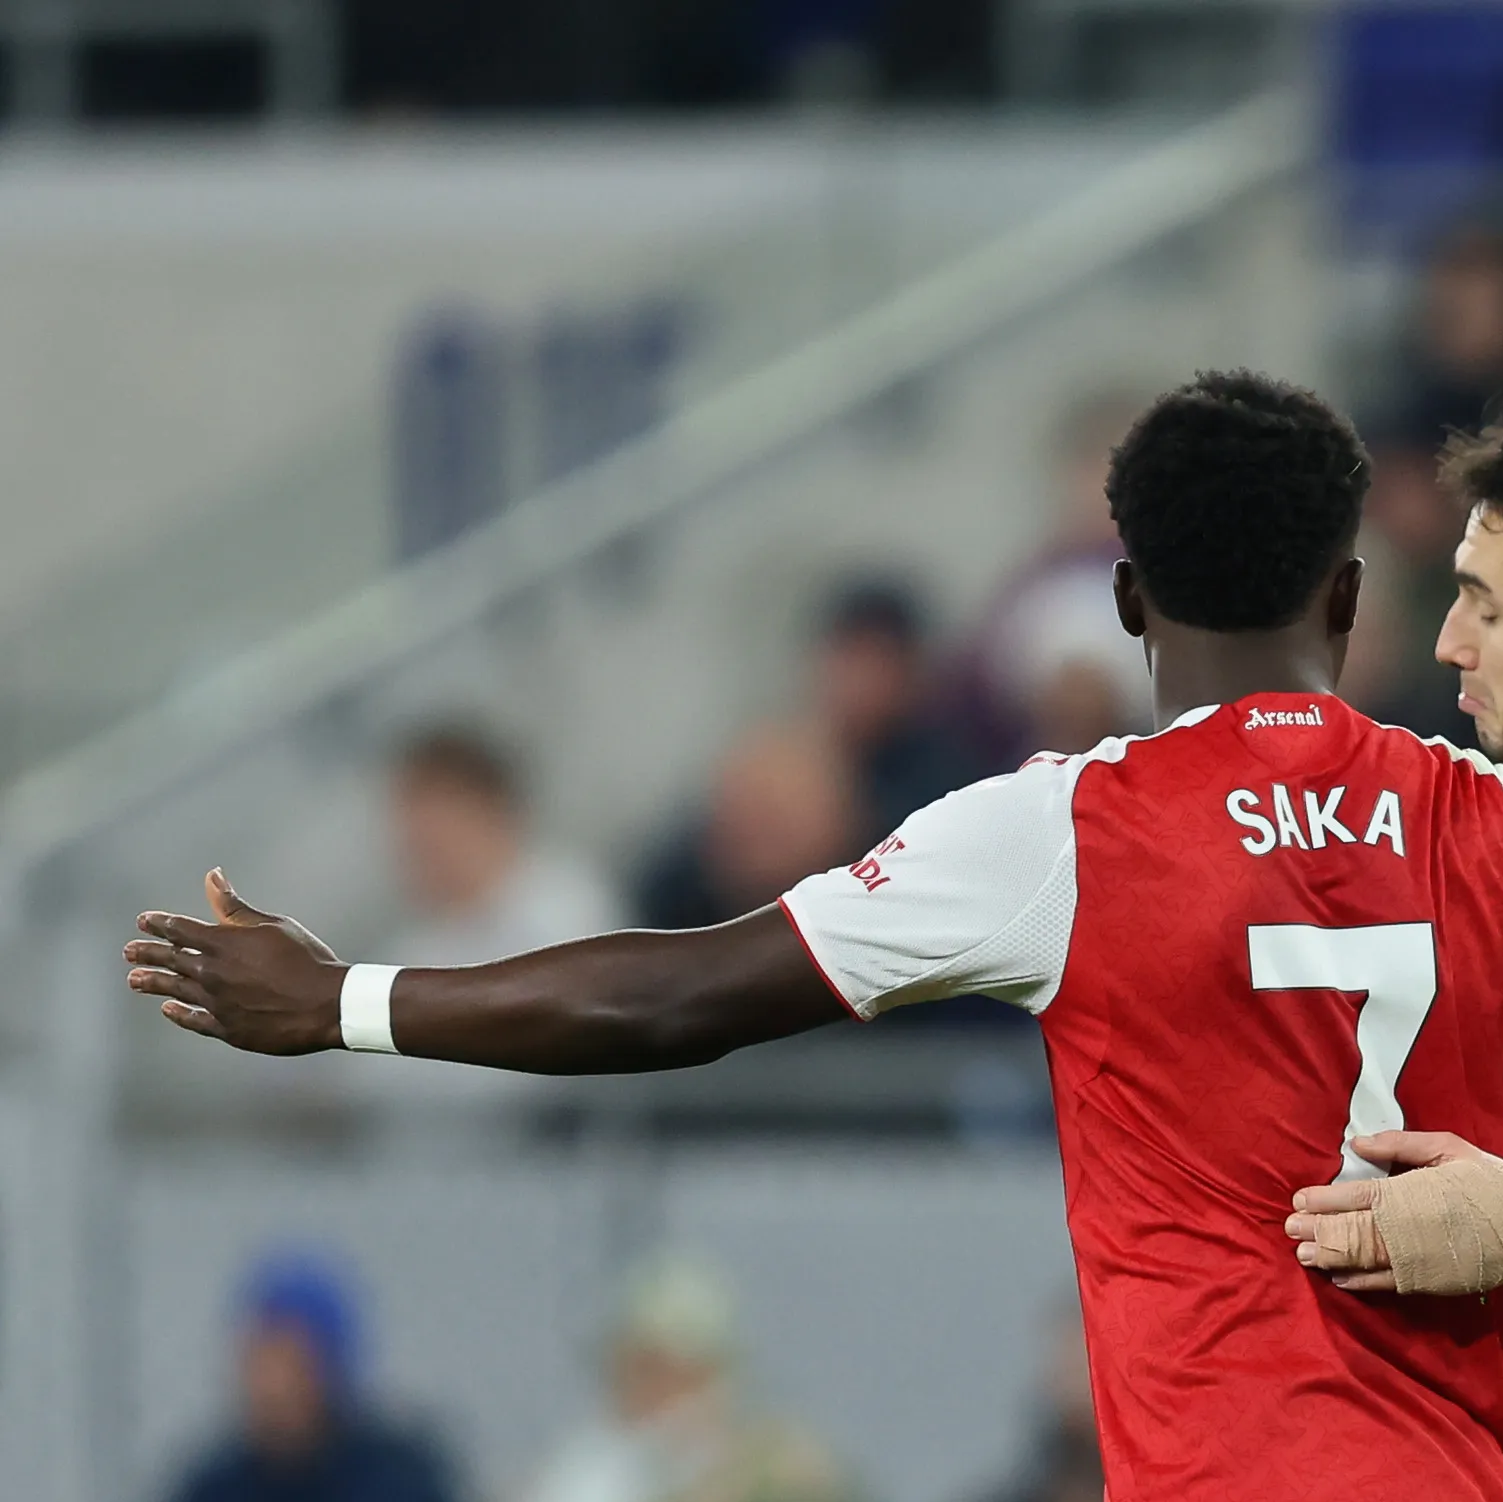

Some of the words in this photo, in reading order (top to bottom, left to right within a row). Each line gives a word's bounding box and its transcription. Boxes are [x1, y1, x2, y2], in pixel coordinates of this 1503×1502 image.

[1244, 704, 1325, 731] Arsenal
[1225, 782, 1407, 858] SAKA
[1247, 921, 1439, 1186] 7
